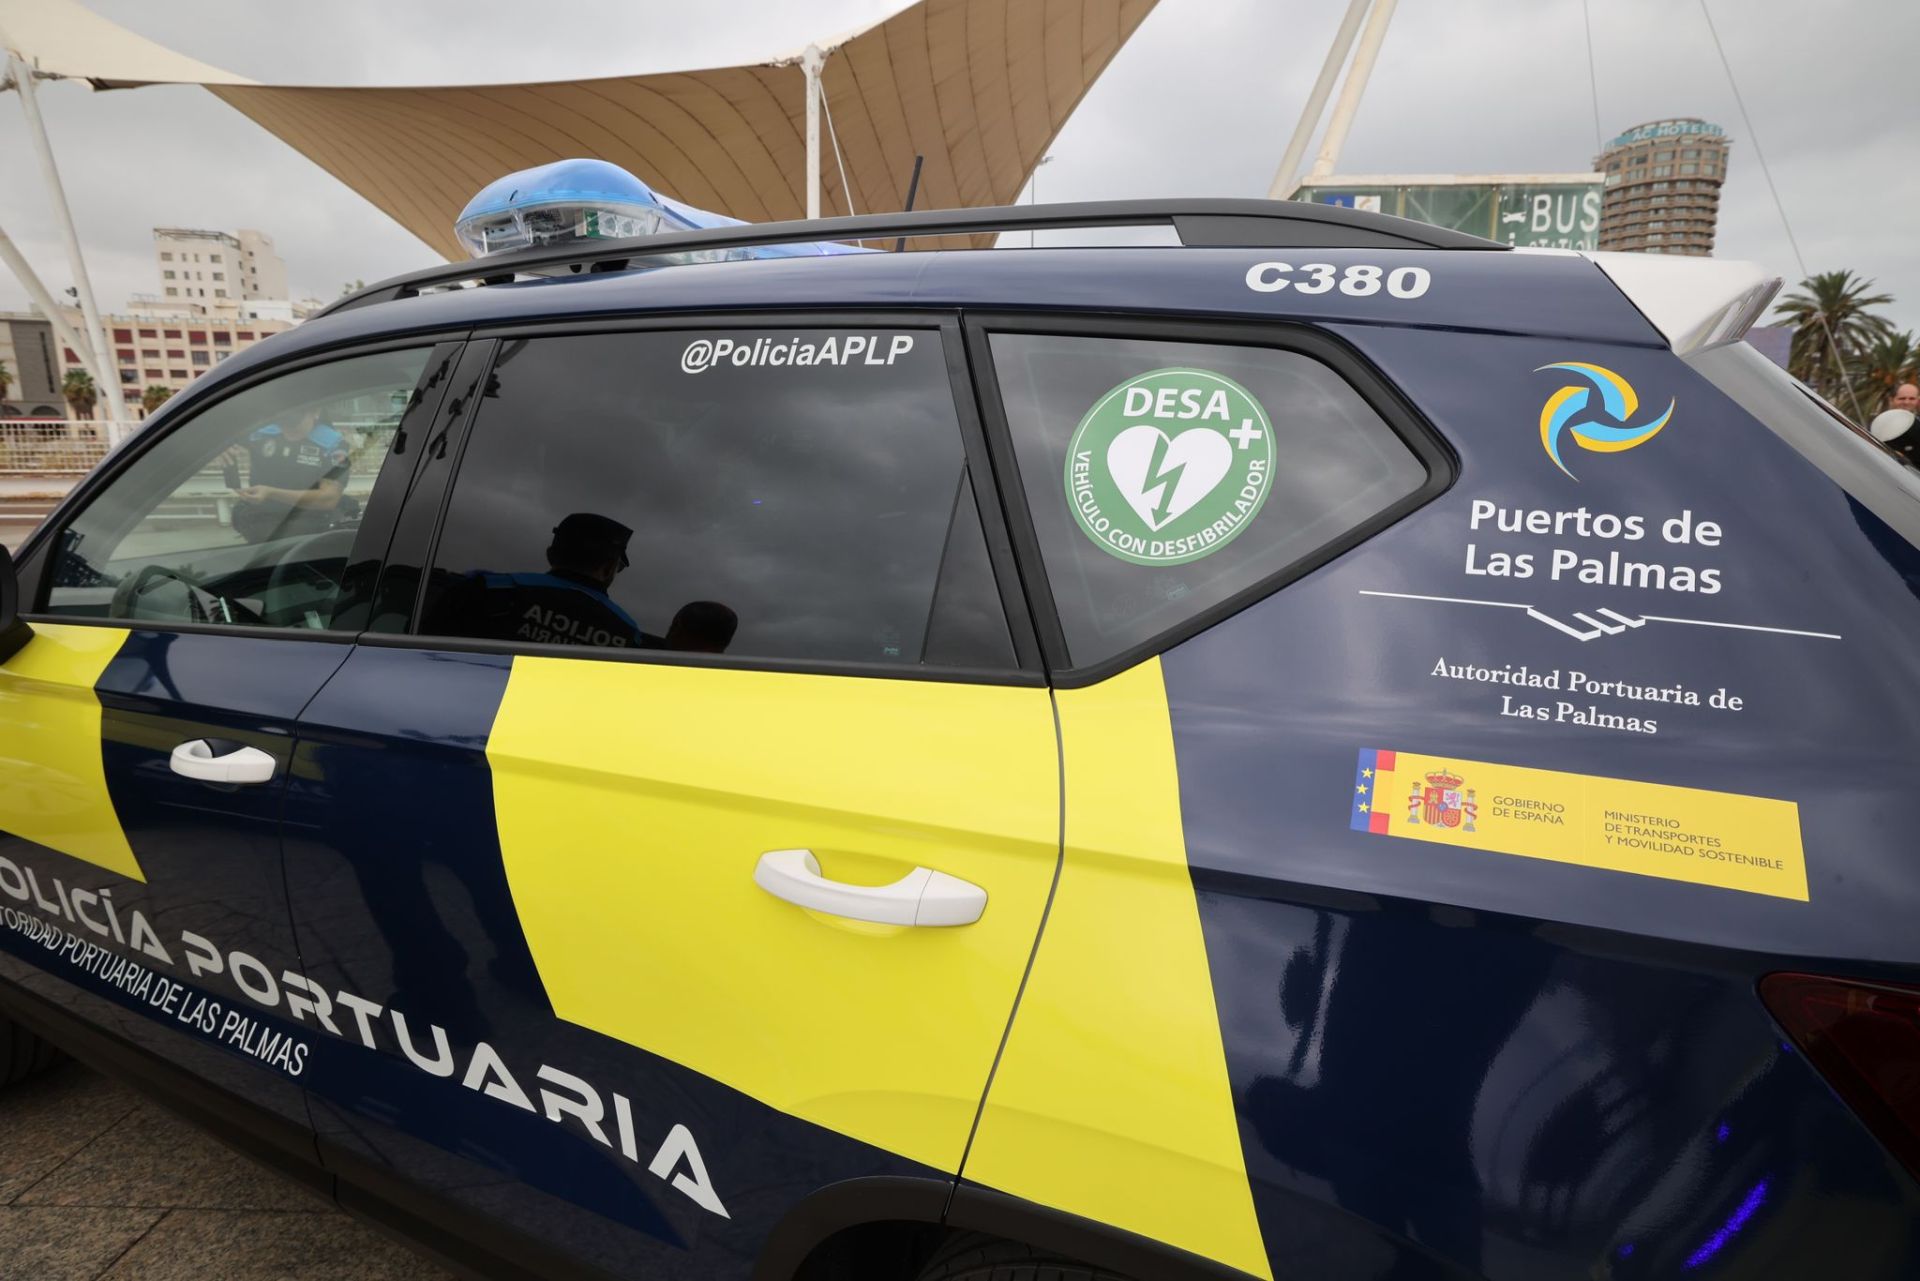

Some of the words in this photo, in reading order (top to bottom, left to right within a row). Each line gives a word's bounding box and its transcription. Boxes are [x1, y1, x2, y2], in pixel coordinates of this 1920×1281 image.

[1531, 191, 1600, 234] BUS
[1245, 261, 1431, 299] C380
[681, 335, 914, 374] @PoliciaAPLP
[1123, 387, 1230, 421] DESA
[1074, 450, 1110, 532] VEHÍCULO
[1108, 528, 1147, 555] CON
[1149, 459, 1266, 556] DESFIBRILADOR
[1470, 500, 1645, 541] Puertos
[1662, 509, 1722, 546] de
[1465, 543, 1535, 578] Las
[1551, 549, 1722, 594] Palmas
[1431, 656, 1560, 690] Autoridad
[1567, 671, 1700, 706] Portuaria
[1709, 688, 1744, 711] de
[1500, 695, 1550, 721] Las
[1556, 702, 1657, 733] Palmas
[1492, 806, 1511, 818] DE
[1514, 809, 1564, 825] ESPAÑA
[1493, 795, 1565, 813] GOBIERNO
[1604, 810, 1680, 829] MINISTERIO
[1604, 822, 1625, 834] DE
[1626, 825, 1721, 848] TRANSPORTES
[1605, 834, 1614, 845] Y
[1617, 837, 1695, 857] MOVILIDAD
[1699, 848, 1784, 871] SOSTENIBLE
[0, 905, 63, 951] TORIDAD
[58, 932, 153, 1000] PORTUARIA
[150, 977, 184, 1015] DE
[178, 991, 221, 1033] LAS
[218, 1010, 308, 1076] PALMAS
[0, 855, 175, 966] OLICÍA
[181, 929, 731, 1219] PORTUARIA
